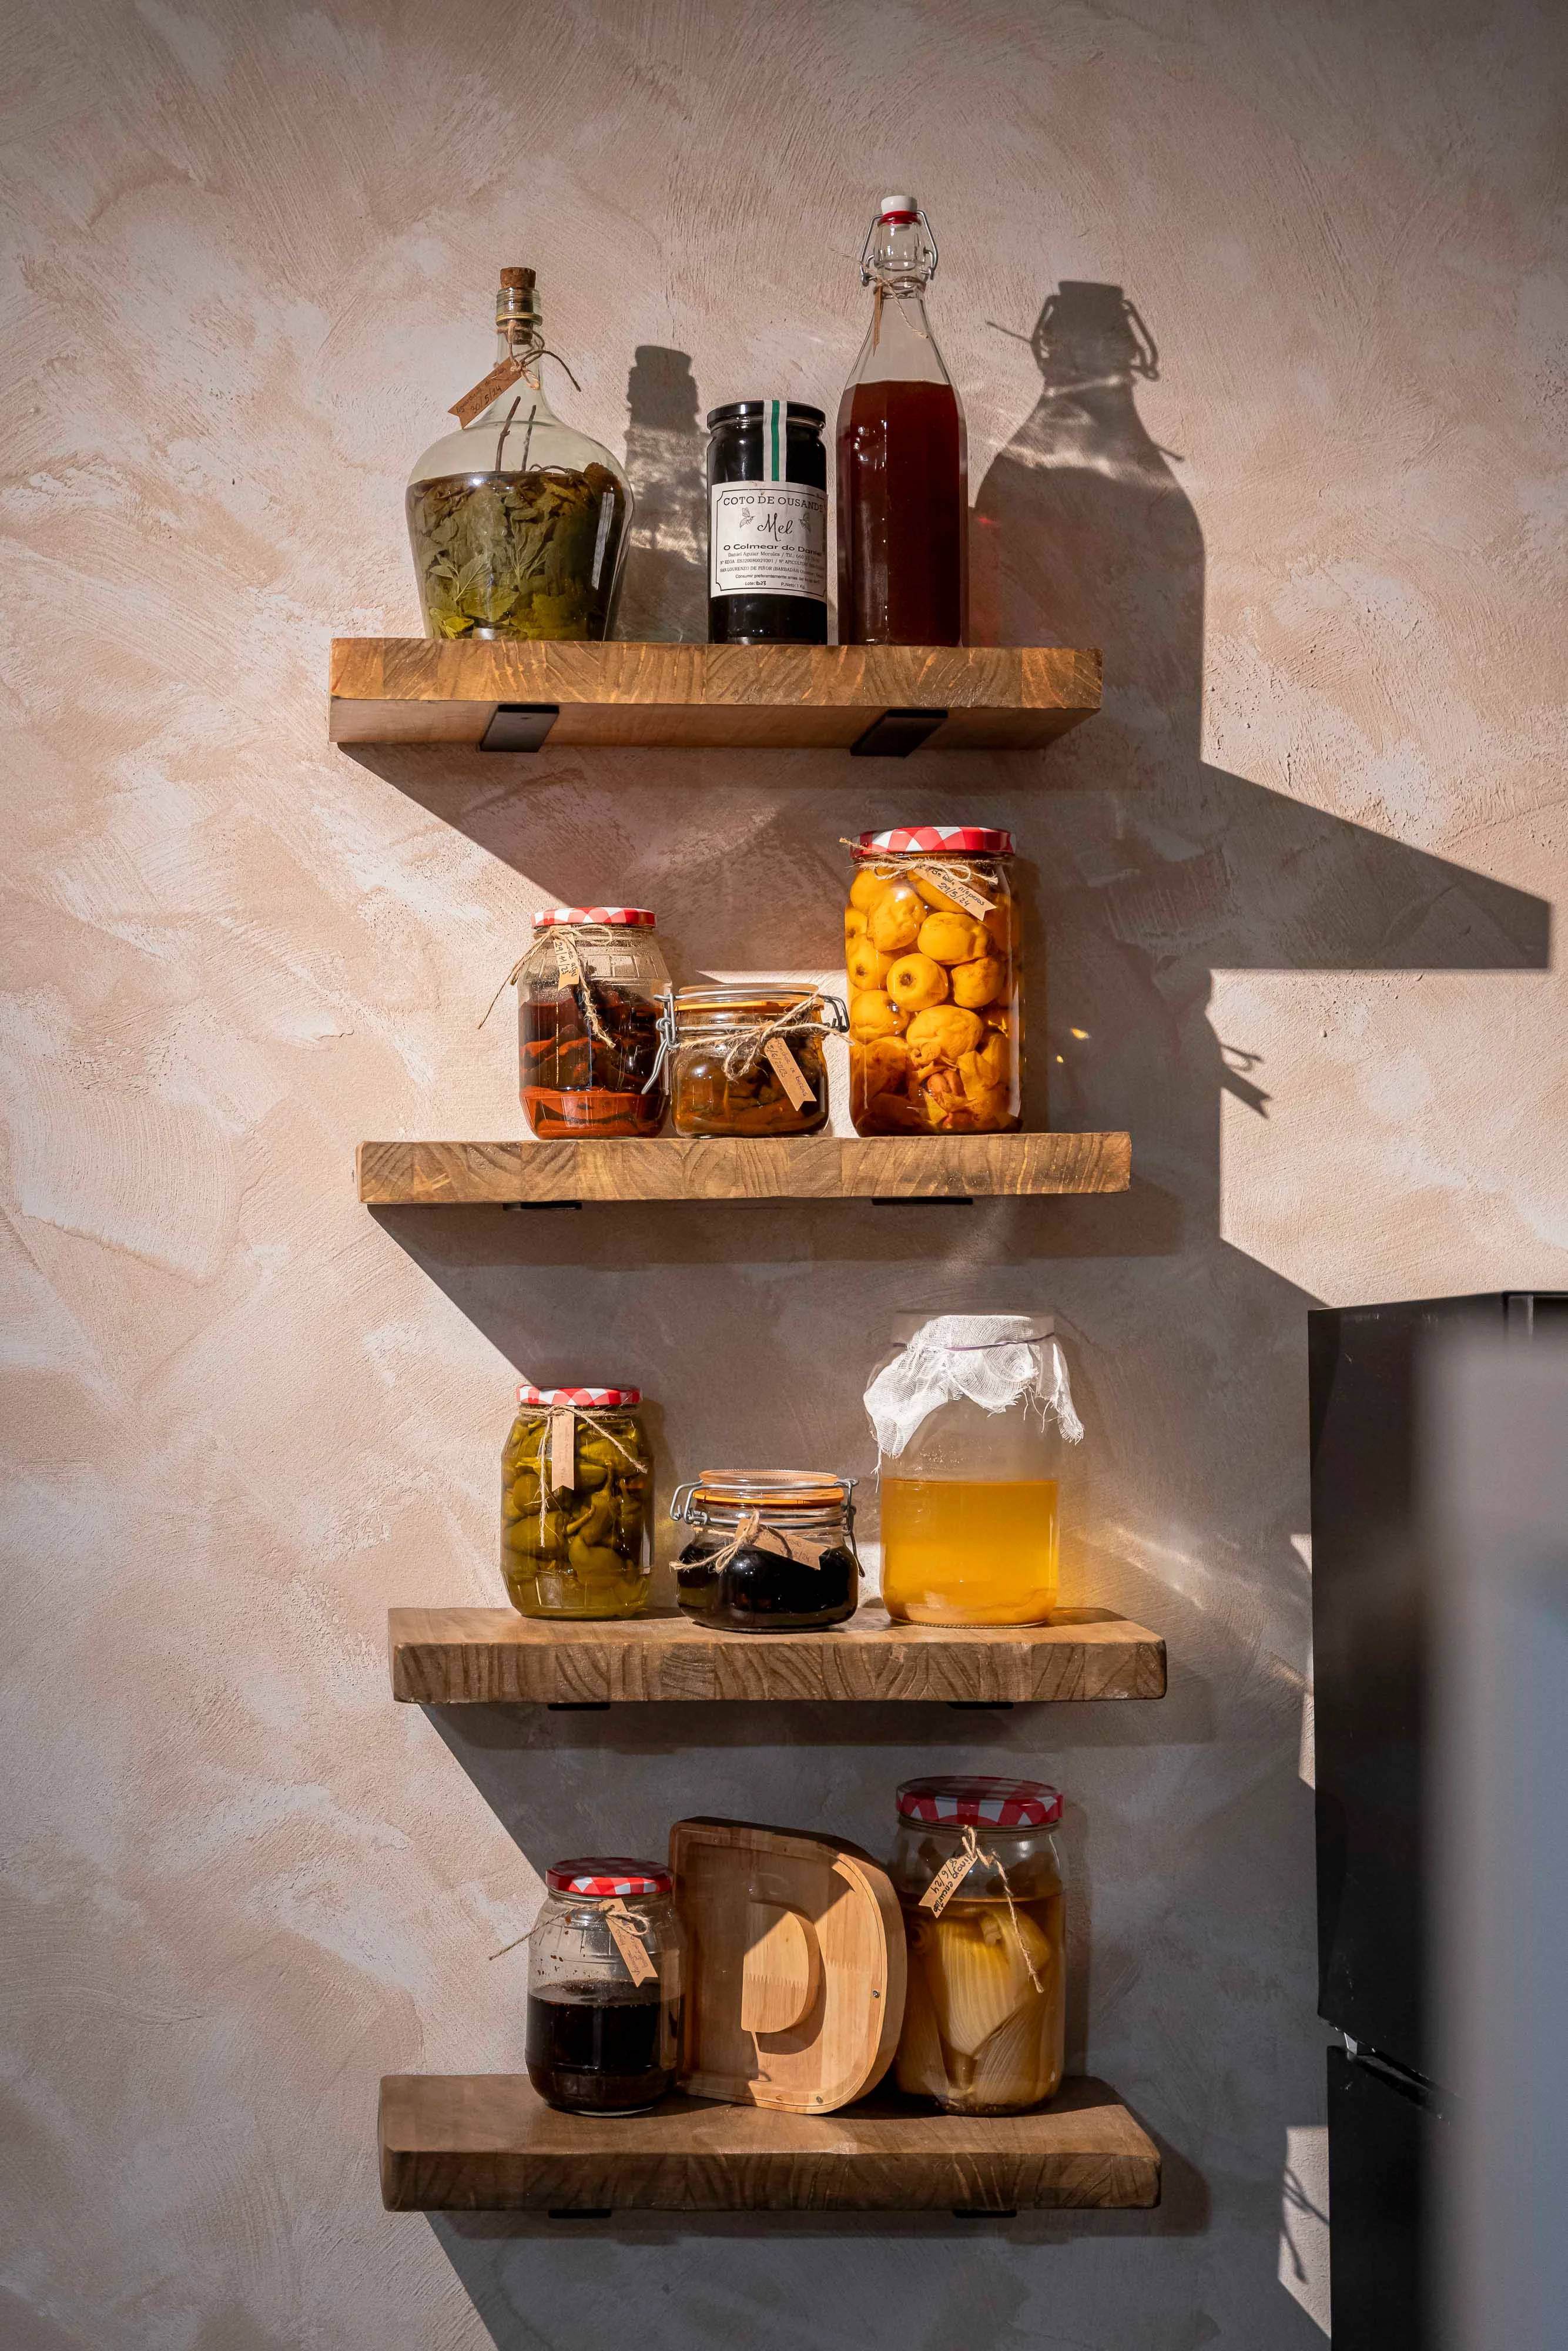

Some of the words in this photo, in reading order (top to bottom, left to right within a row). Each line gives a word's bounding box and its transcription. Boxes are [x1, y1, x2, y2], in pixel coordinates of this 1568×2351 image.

[723, 496, 755, 505] COTO
[757, 513, 793, 541] Mel
[937, 882, 970, 907] 29/5/24
